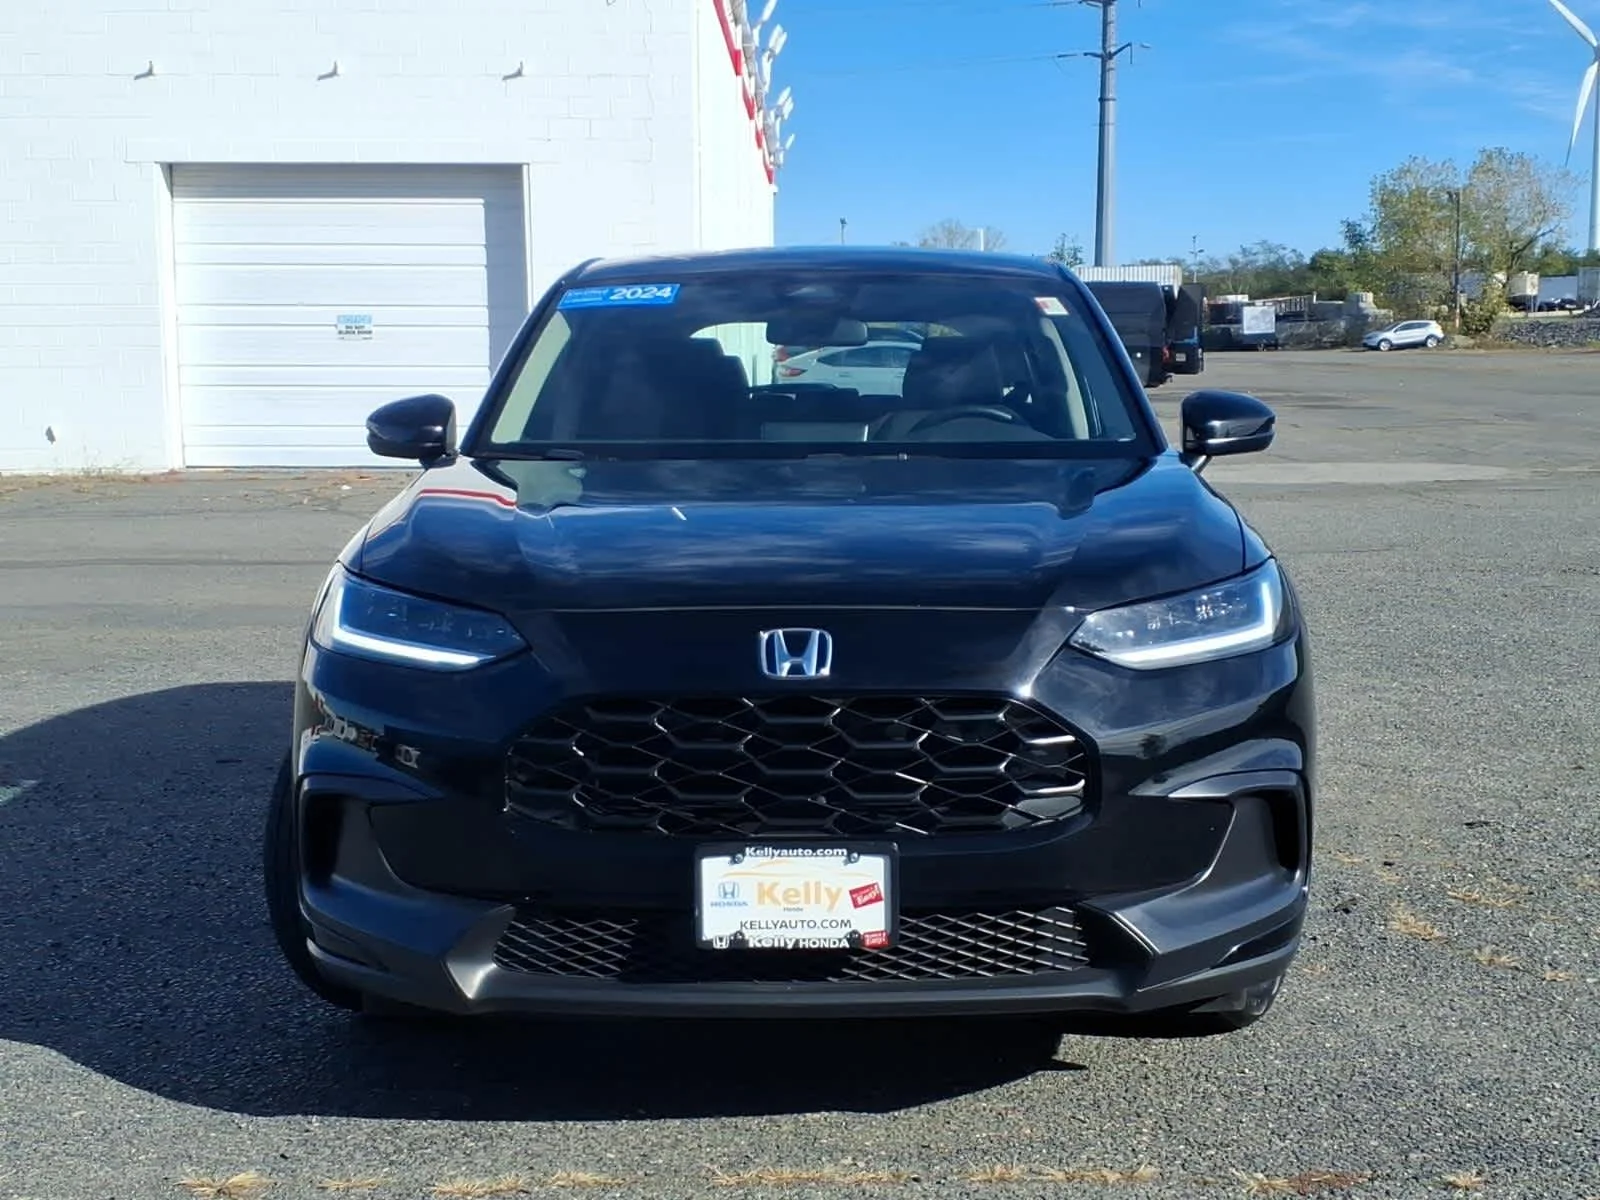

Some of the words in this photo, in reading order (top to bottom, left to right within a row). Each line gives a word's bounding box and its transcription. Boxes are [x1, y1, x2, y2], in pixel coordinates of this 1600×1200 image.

[609, 286, 672, 300] 2024
[745, 847, 847, 858] Kellyauto.com
[757, 881, 842, 912] Kelly
[740, 919, 852, 930] KELLYAUTO.COM
[748, 935, 796, 949] Kelly
[800, 939, 849, 948] HONDA
